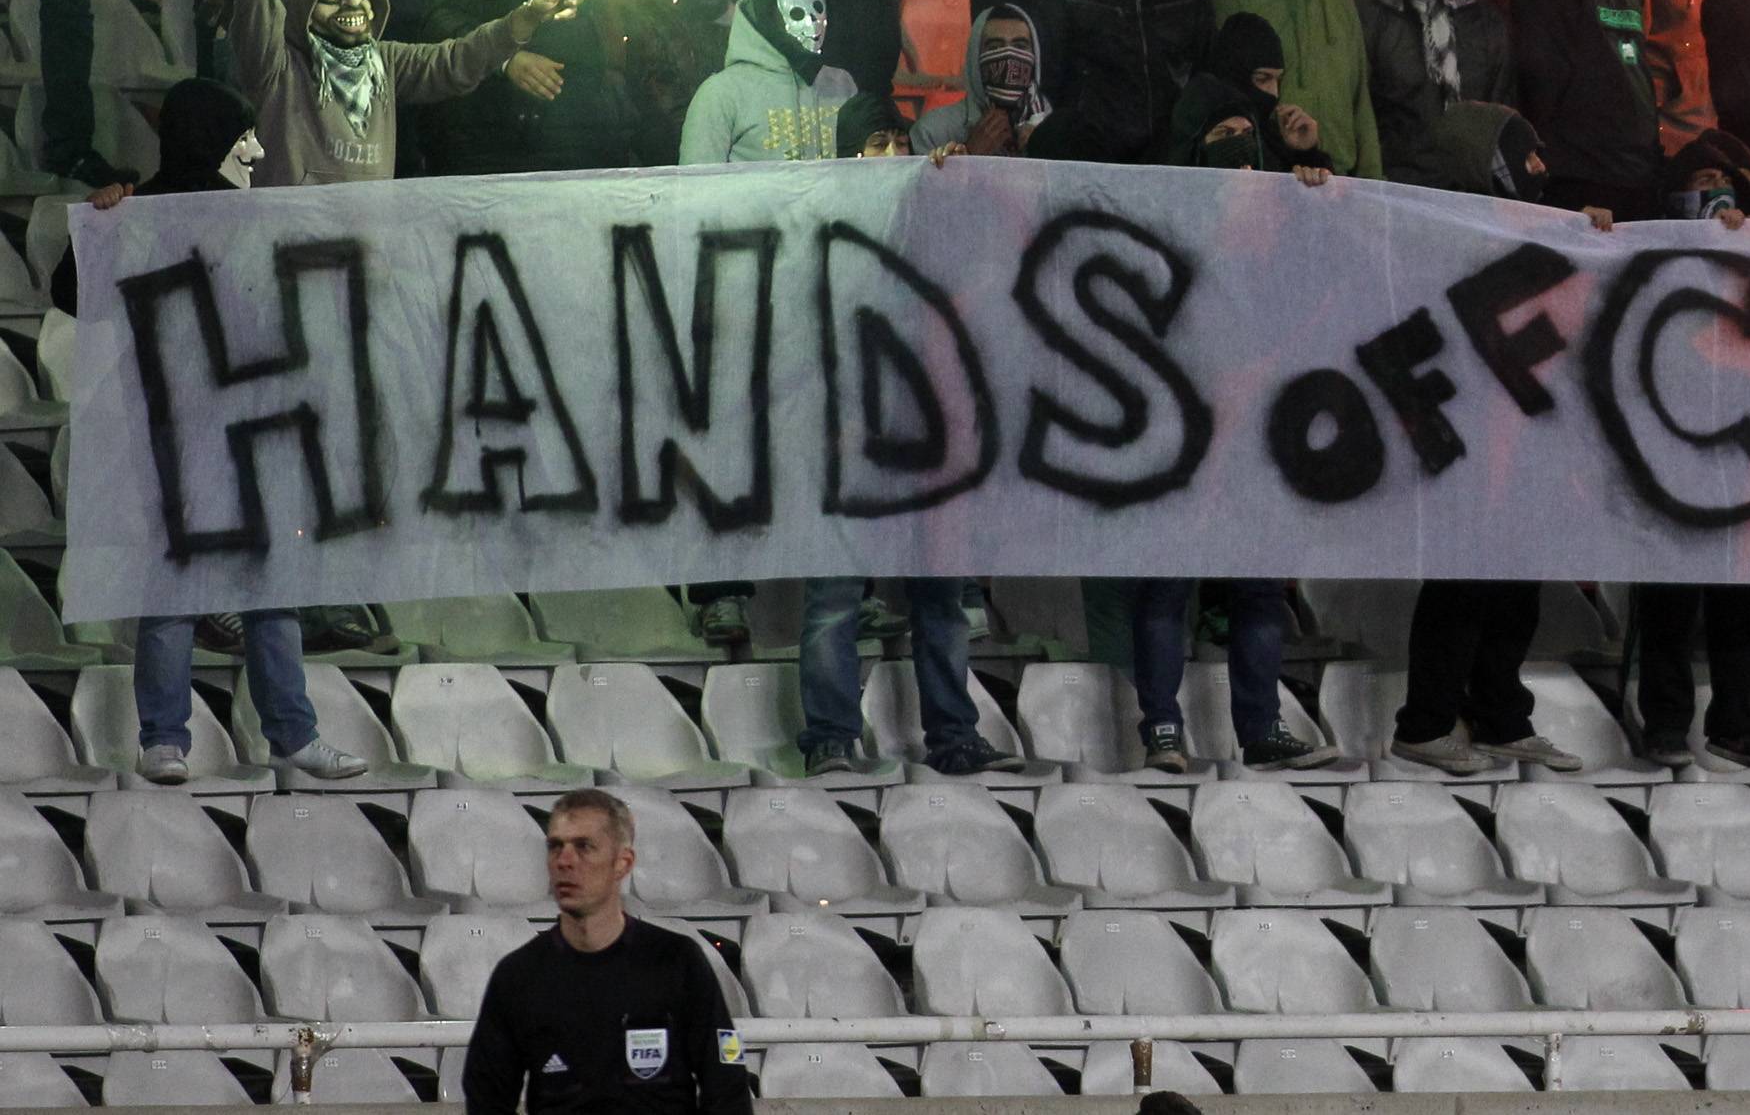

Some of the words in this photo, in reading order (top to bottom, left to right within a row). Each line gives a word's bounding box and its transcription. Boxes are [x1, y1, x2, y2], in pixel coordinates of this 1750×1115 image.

[118, 210, 1213, 559] HANDS
[1263, 242, 1577, 502] OFF
[632, 1048, 661, 1060] FIFA
